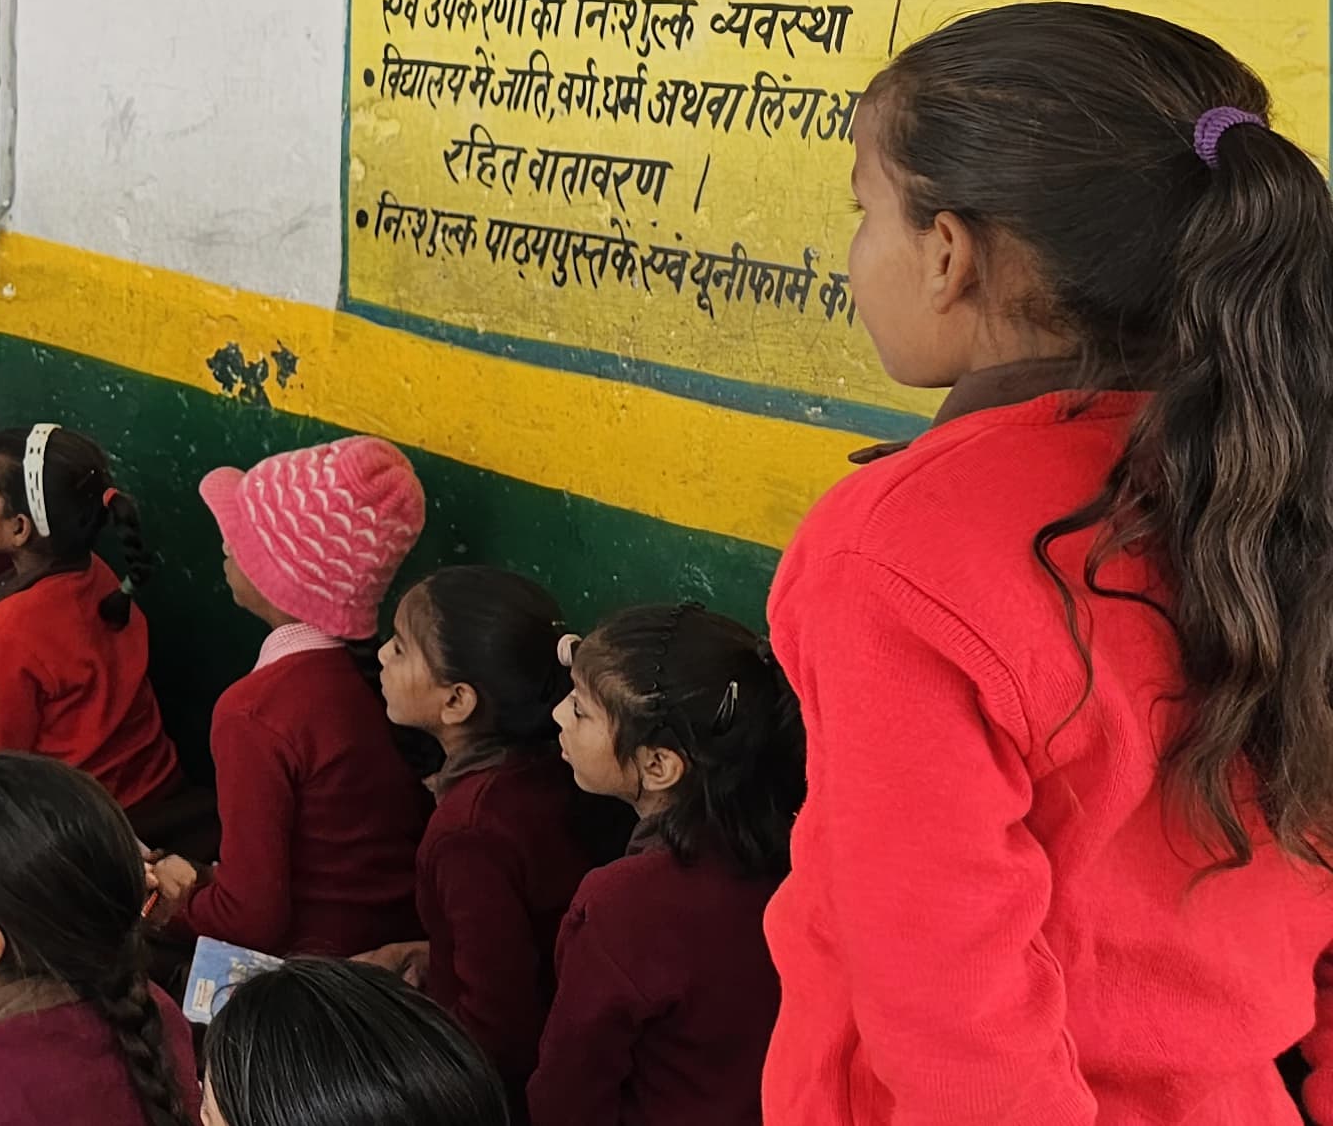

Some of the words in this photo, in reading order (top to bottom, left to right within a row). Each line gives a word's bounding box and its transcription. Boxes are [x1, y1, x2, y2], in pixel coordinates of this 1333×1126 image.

[710, 1, 853, 58] व्यवस्था
[381, 44, 471, 113] विद्यालय
[469, 47, 497, 110] में
[647, 77, 748, 133] अथवा
[746, 71, 828, 140] लिंग
[443, 124, 527, 196] रहित
[528, 147, 672, 213] वातावरण
